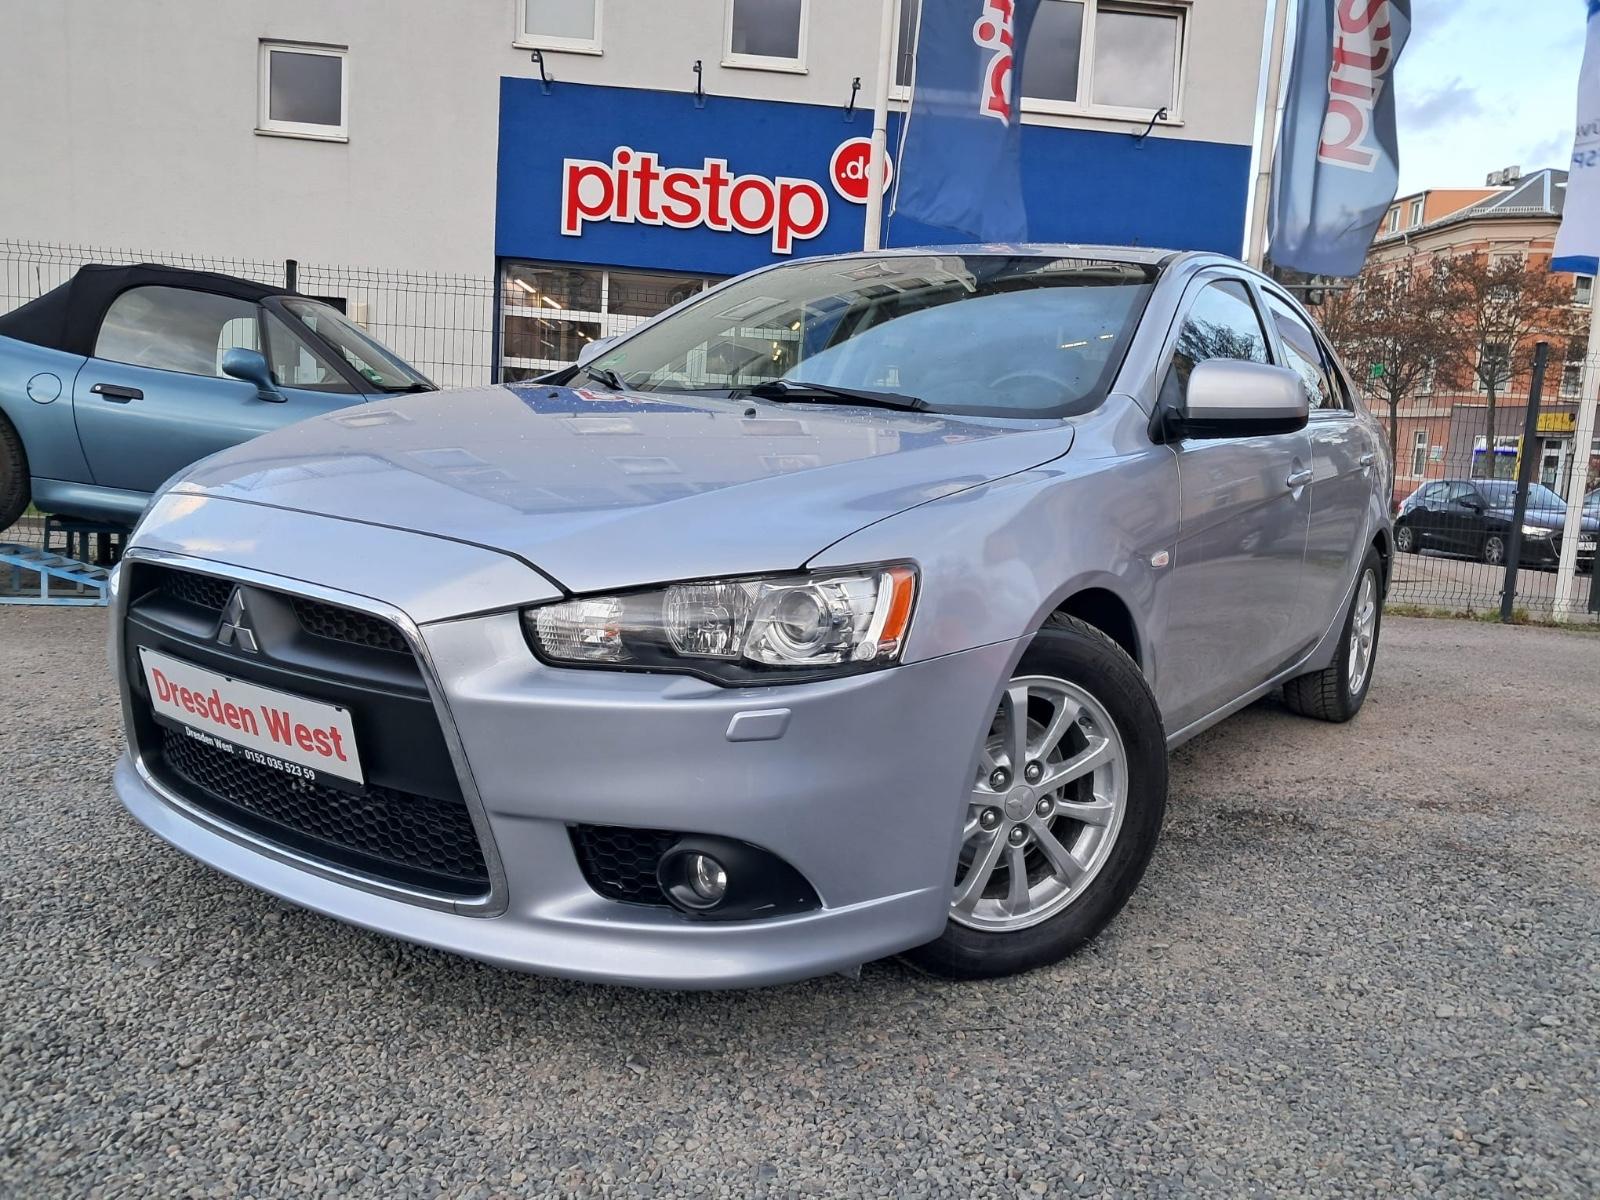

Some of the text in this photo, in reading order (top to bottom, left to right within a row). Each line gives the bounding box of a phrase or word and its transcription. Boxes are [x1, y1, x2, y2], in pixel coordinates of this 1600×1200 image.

[564, 146, 827, 252] pitstop
[152, 667, 347, 761] Dresden West
[184, 726, 316, 781] Dresden West 0152 035 523 59
